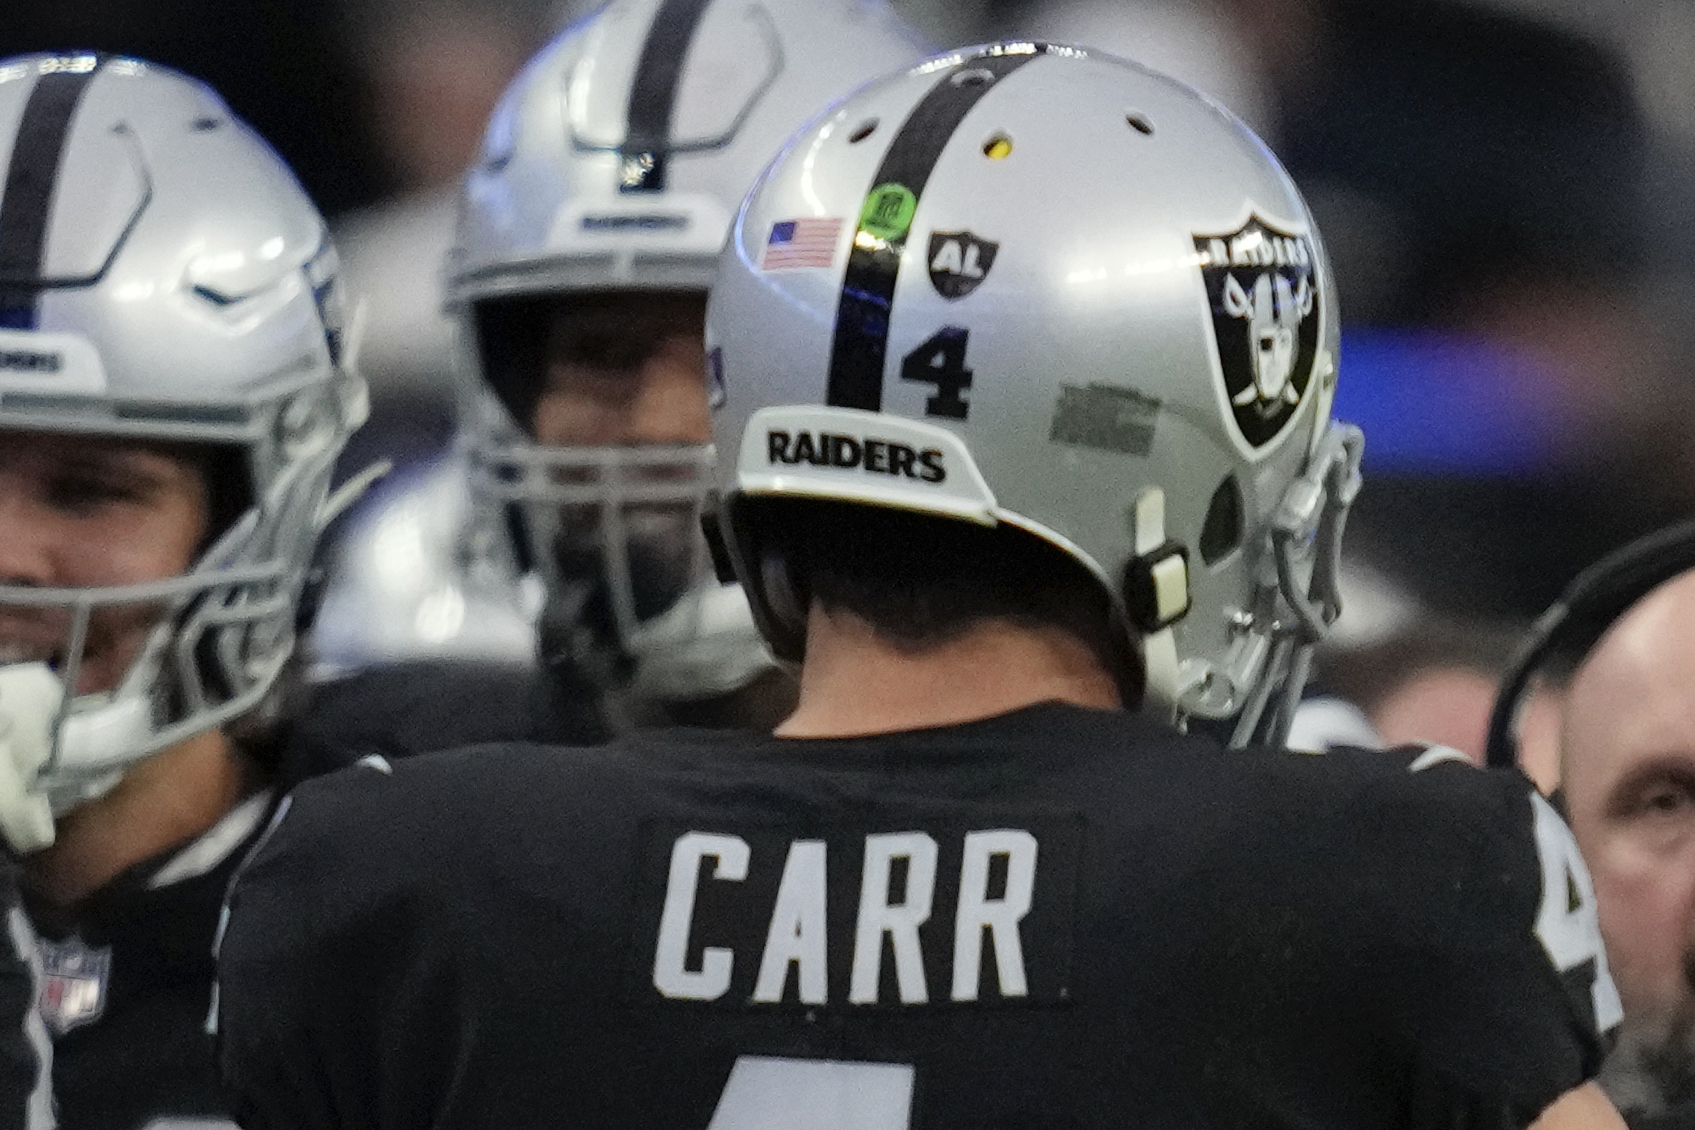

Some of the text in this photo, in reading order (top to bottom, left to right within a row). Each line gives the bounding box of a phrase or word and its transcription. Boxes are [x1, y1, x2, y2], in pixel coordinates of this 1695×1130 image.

[931, 238, 985, 278] AL
[902, 327, 973, 418] 4
[767, 431, 946, 483] RAIDERS
[653, 828, 1039, 1004] CARR
[1532, 790, 1624, 1033] 4
